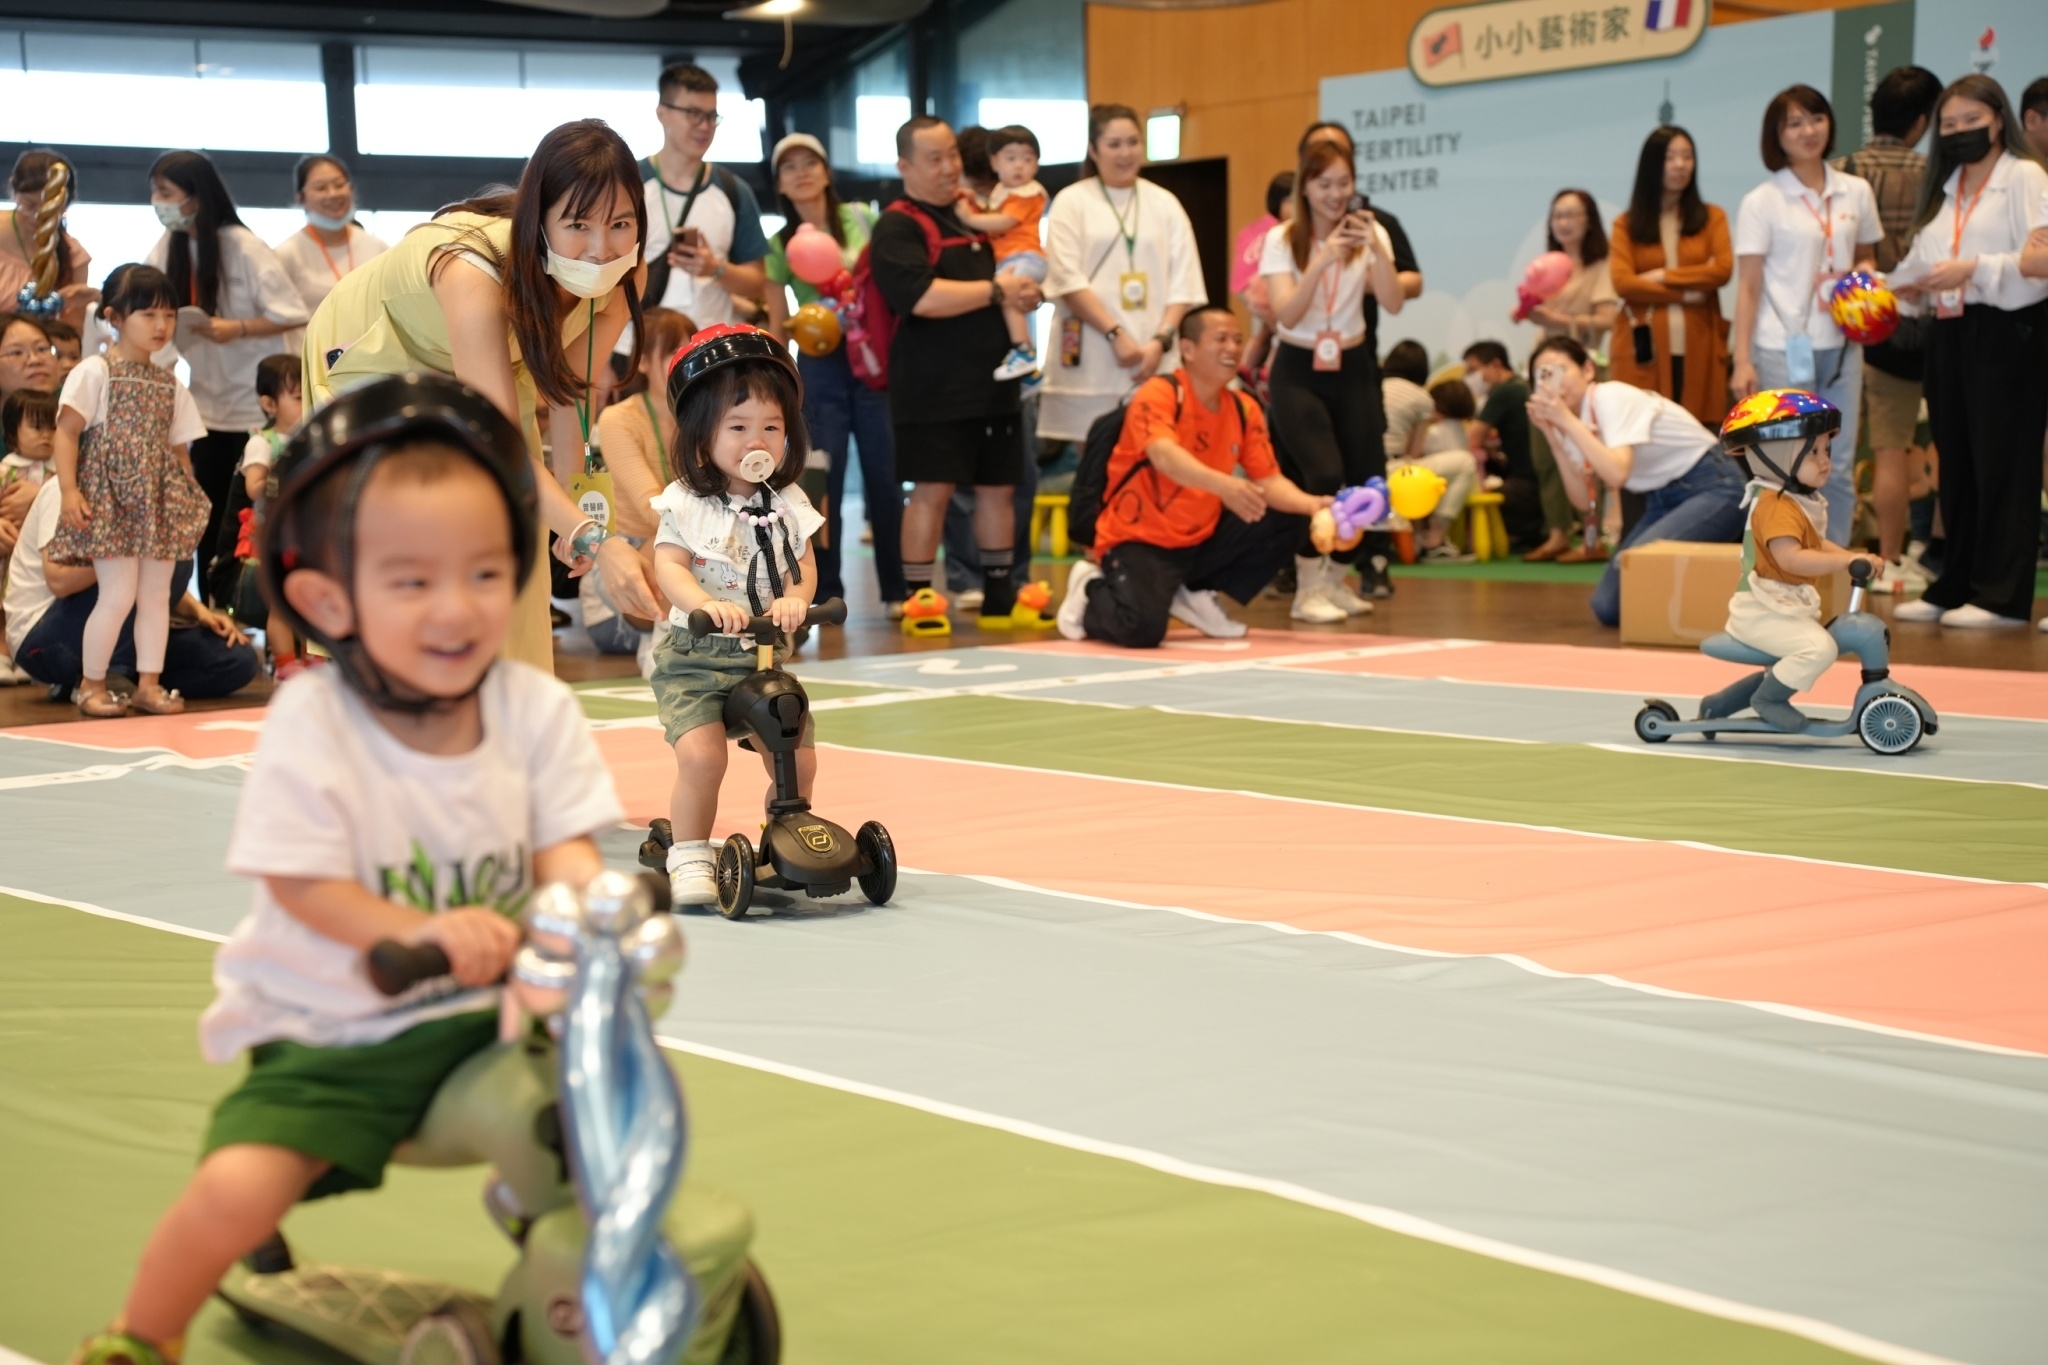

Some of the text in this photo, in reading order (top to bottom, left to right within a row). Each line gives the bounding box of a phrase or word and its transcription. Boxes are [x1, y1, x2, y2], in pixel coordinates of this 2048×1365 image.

[1475, 6, 1630, 60] 小小藝術家
[1351, 102, 1426, 131] TAIPEI
